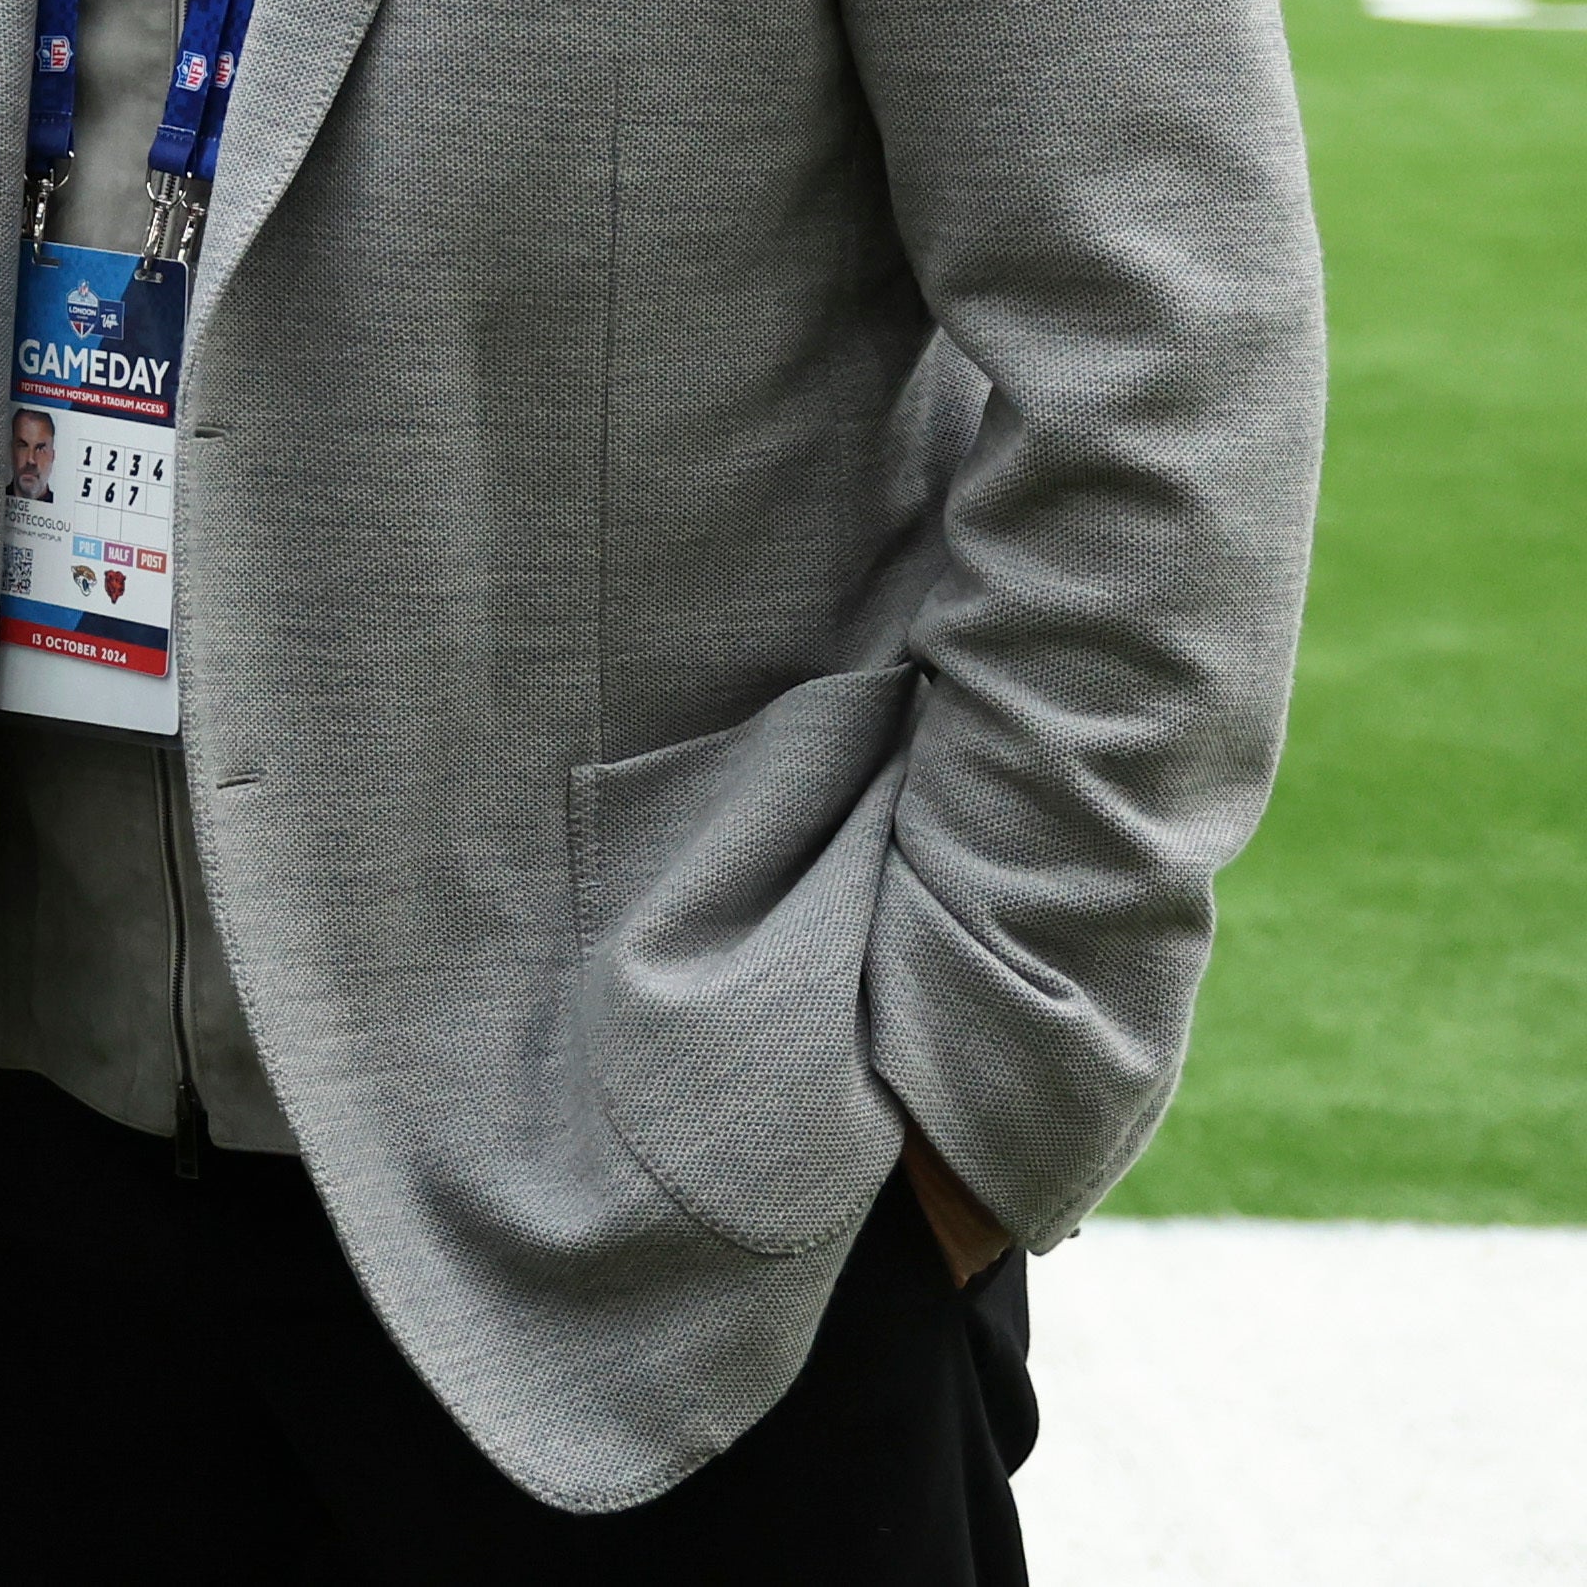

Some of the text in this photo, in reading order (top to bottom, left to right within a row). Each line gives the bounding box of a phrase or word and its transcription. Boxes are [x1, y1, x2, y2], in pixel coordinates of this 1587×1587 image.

[51, 40, 66, 67] NFL
[188, 59, 204, 86] NFL
[68, 305, 97, 317] LONDON
[18, 338, 171, 395] GAMEDAY
[21, 381, 166, 415] TOTTENHAM HOTSPUR STADIUM ACCESS
[83, 446, 164, 481] 1 2 3 4
[81, 477, 139, 506] 5 6 7
[79, 540, 96, 554] PRE
[108, 547, 130, 562] HALF
[140, 553, 164, 569] POST
[32, 633, 127, 664] 13 OCTOBER 2024
